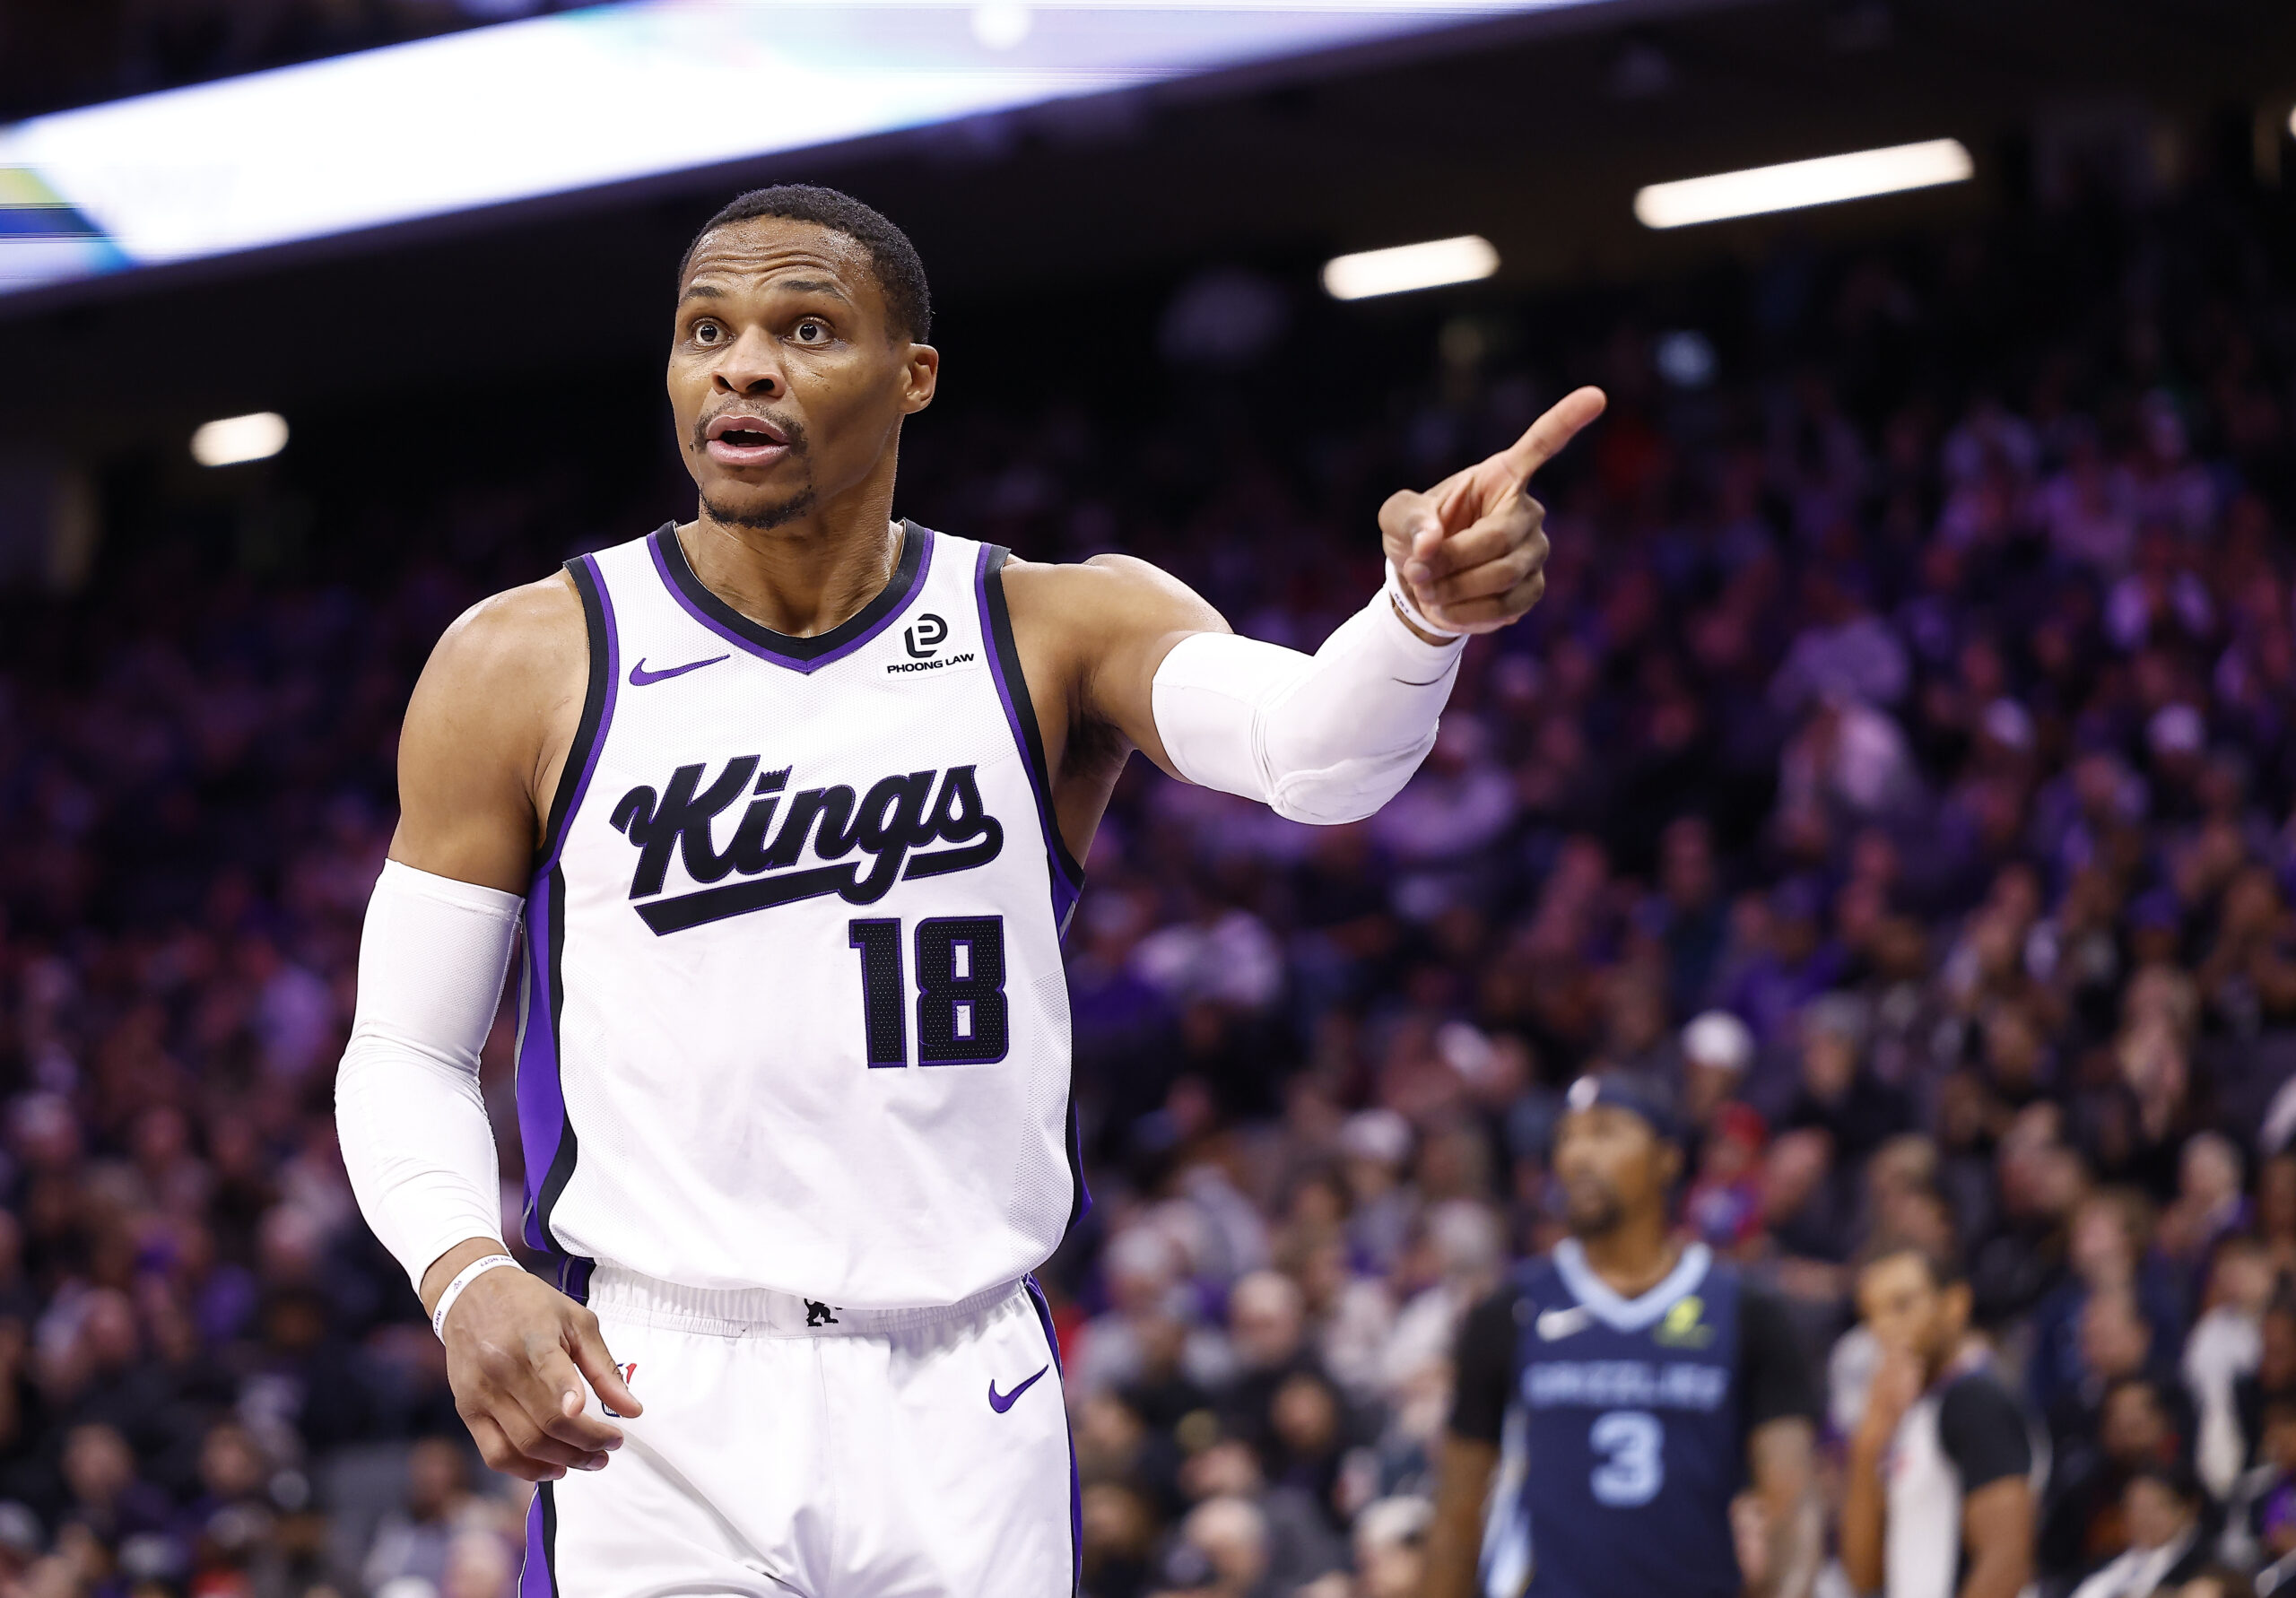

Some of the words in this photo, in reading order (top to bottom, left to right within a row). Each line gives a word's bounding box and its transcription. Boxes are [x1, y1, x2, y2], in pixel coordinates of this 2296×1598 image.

[887, 660, 943, 673] PHOONG
[945, 654, 974, 665] LAW
[609, 755, 1004, 936] Kings
[848, 915, 1009, 1069] 18
[1590, 1411, 1664, 1506] 3
